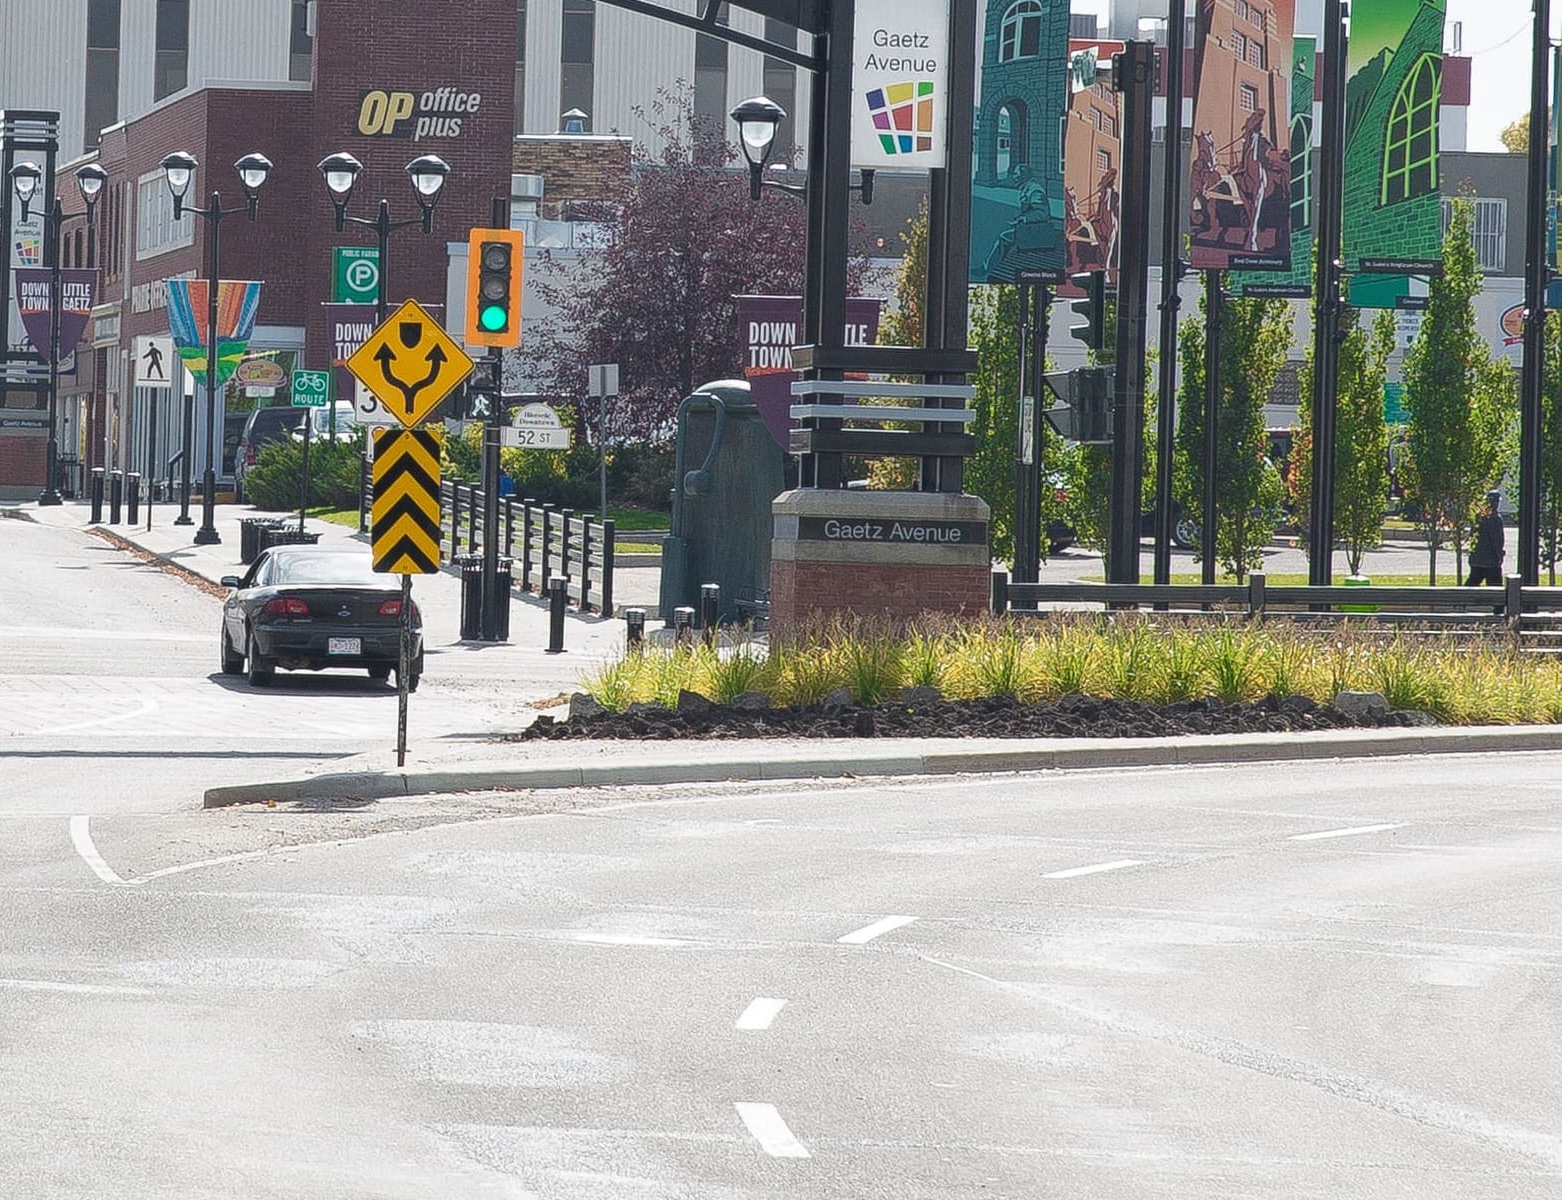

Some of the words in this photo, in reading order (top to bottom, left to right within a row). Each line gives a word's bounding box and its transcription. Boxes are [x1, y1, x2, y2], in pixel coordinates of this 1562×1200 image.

[873, 29, 929, 48] Gaetz
[864, 53, 937, 73] Avenue
[419, 87, 481, 112] office
[358, 90, 415, 136] OP
[414, 116, 463, 142] plus
[21, 282, 49, 296] DOWN
[63, 283, 91, 297] LITTLE
[21, 297, 49, 310] TOWN
[62, 297, 91, 311] GAETZ
[335, 323, 372, 342] DOWN
[749, 322, 796, 345] DOWN
[294, 393, 324, 404] ROUTE
[518, 430, 535, 445] 52
[539, 432, 551, 443] ST
[824, 519, 883, 539] Gaetz
[889, 522, 961, 542] Avenue
